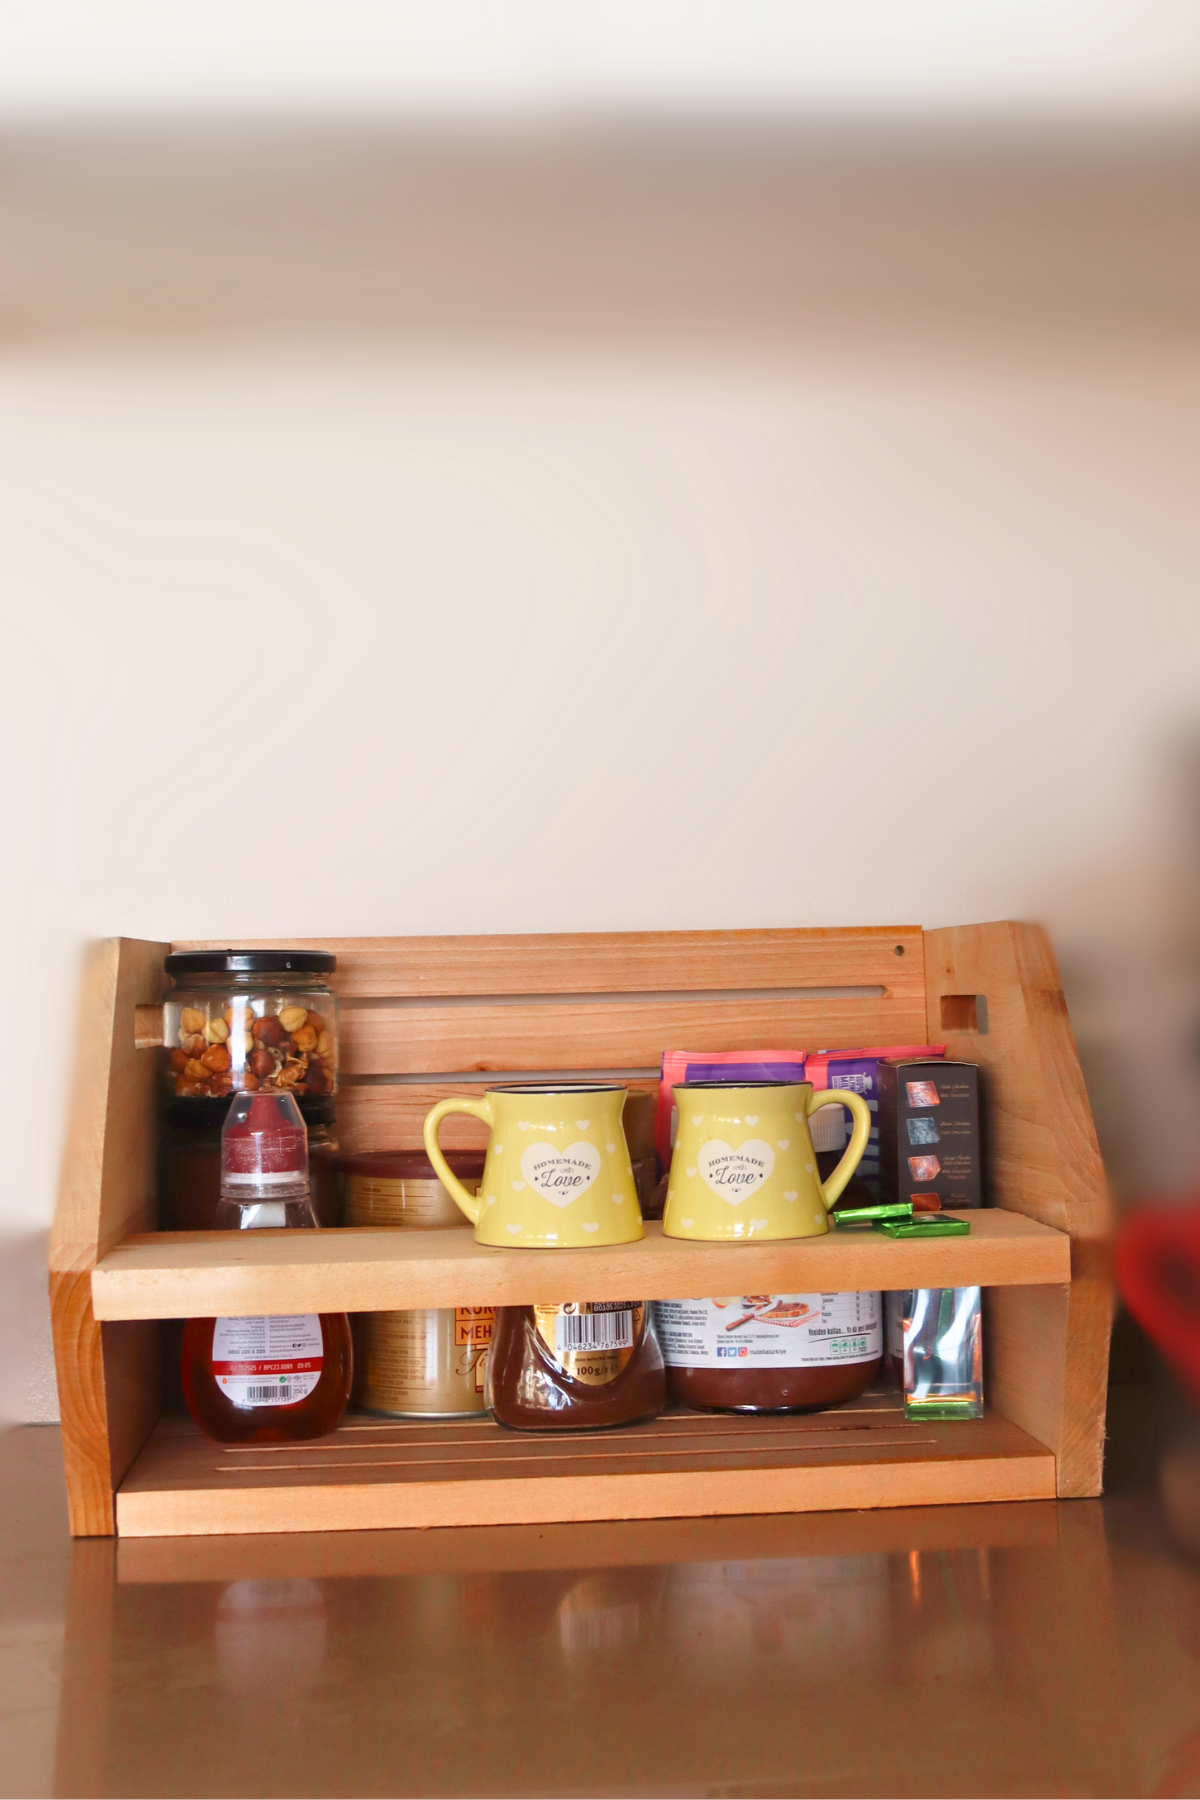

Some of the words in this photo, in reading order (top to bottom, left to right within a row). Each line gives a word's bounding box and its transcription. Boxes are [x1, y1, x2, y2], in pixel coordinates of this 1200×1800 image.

[534, 1158, 592, 1170] HOMEMADE
[708, 1155, 765, 1168] HOMEMADE
[541, 1168, 584, 1187] Love
[715, 1165, 757, 1184] Love
[460, 1307, 495, 1315] KUR
[567, 1342, 597, 1351] 046234
[600, 1340, 627, 1349] 767599
